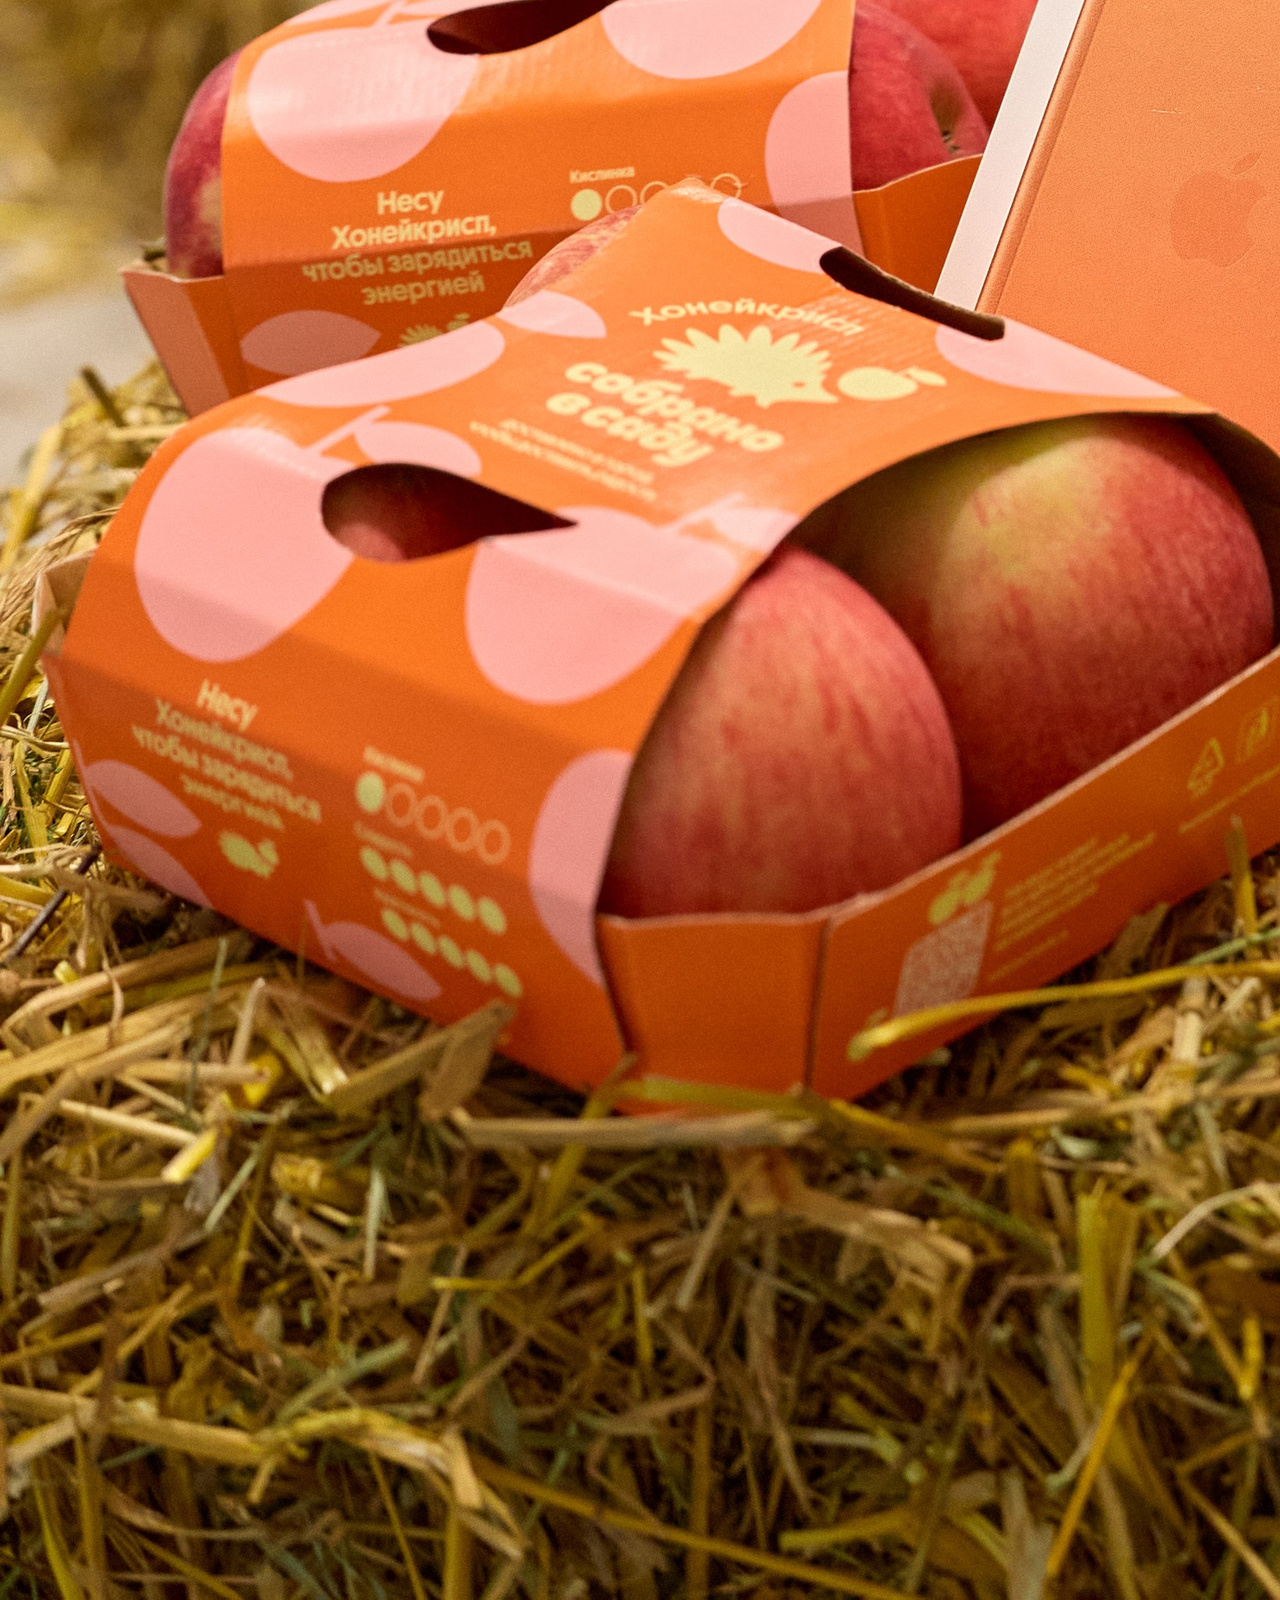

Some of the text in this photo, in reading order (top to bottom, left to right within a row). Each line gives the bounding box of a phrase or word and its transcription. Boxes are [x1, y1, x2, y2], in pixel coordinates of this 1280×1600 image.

[377, 190, 444, 215] Несу
[331, 214, 497, 250] Хонейкрисп,
[302, 240, 534, 283] чтобы зарядиться
[361, 270, 486, 306] энергией
[628, 298, 865, 337] Хонейкрисп
[565, 362, 784, 452] собрано
[546, 392, 592, 416] в
[580, 406, 714, 468] саду
[196, 679, 259, 732] Несу
